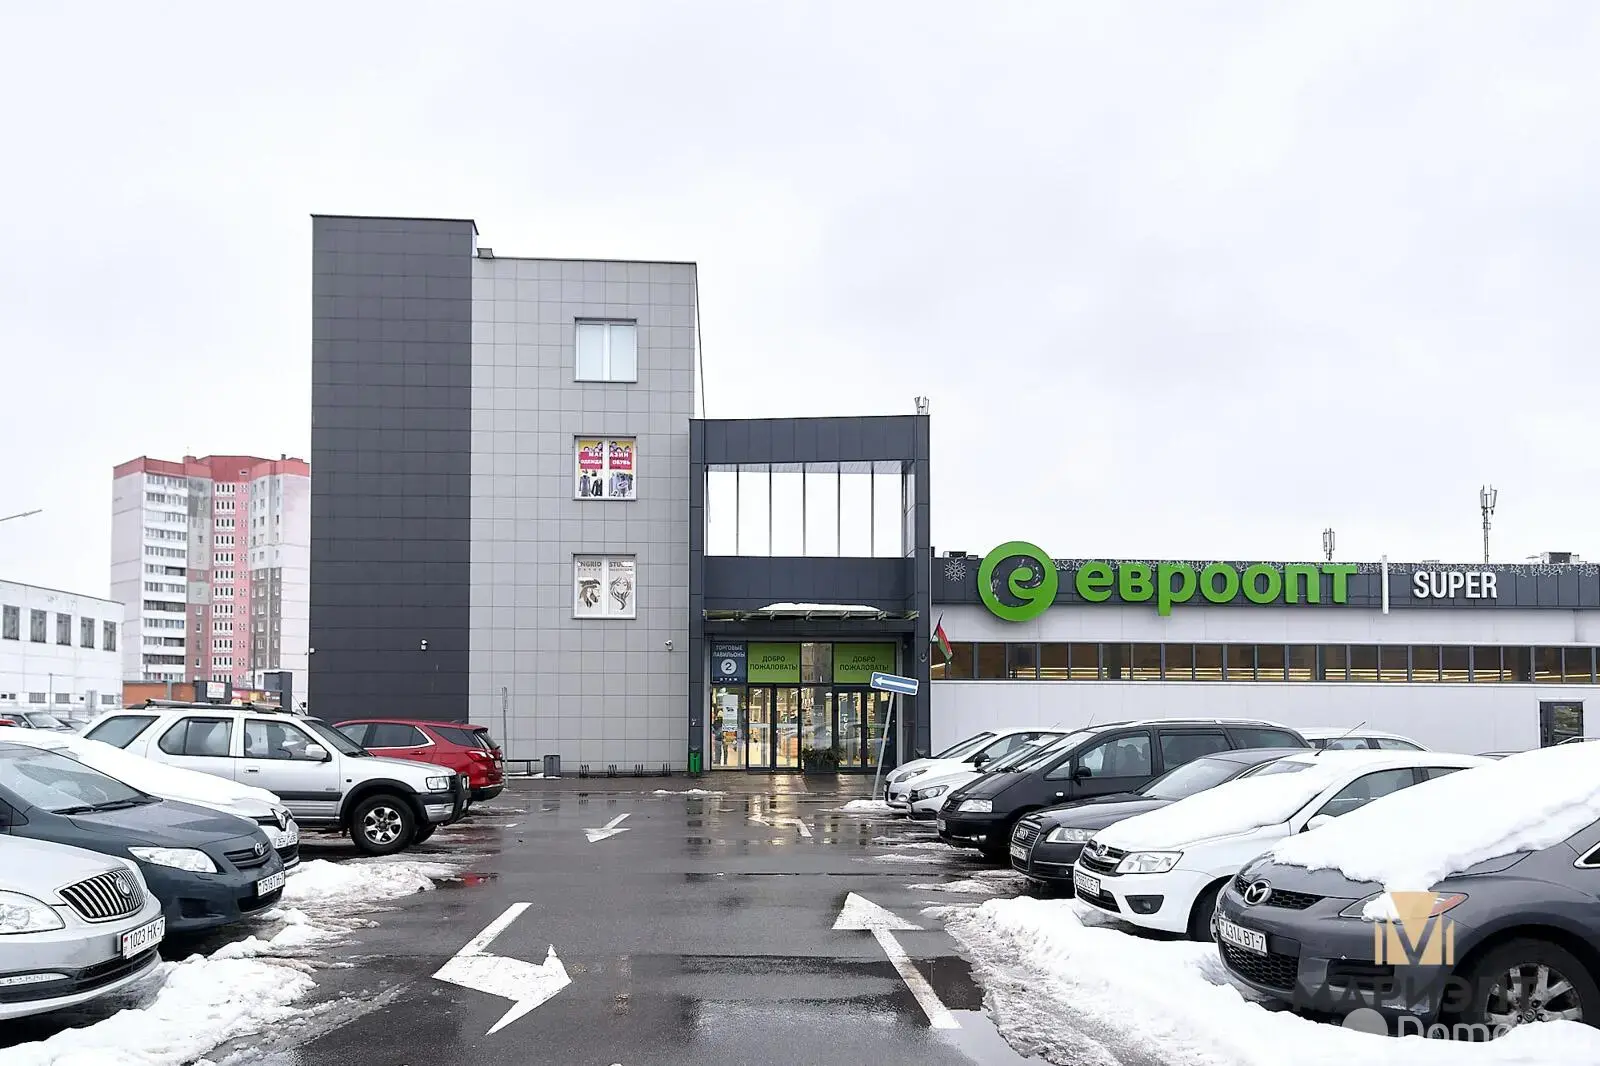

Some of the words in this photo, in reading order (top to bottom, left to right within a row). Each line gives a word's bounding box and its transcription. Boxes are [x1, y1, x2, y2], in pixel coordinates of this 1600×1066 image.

[1075, 562, 1358, 616] евроопт
[1413, 571, 1498, 598] SUPER
[725, 662, 732, 671] 2
[749, 663, 799, 671] ПОЖАЛОВАТЬ!
[762, 655, 786, 663] ДОБРО
[852, 655, 876, 663] ДОБРО
[130, 928, 146, 949] 1023
[147, 919, 164, 941] HX-7
[1225, 922, 1242, 944] 4314
[1243, 929, 1264, 951] BT-7
